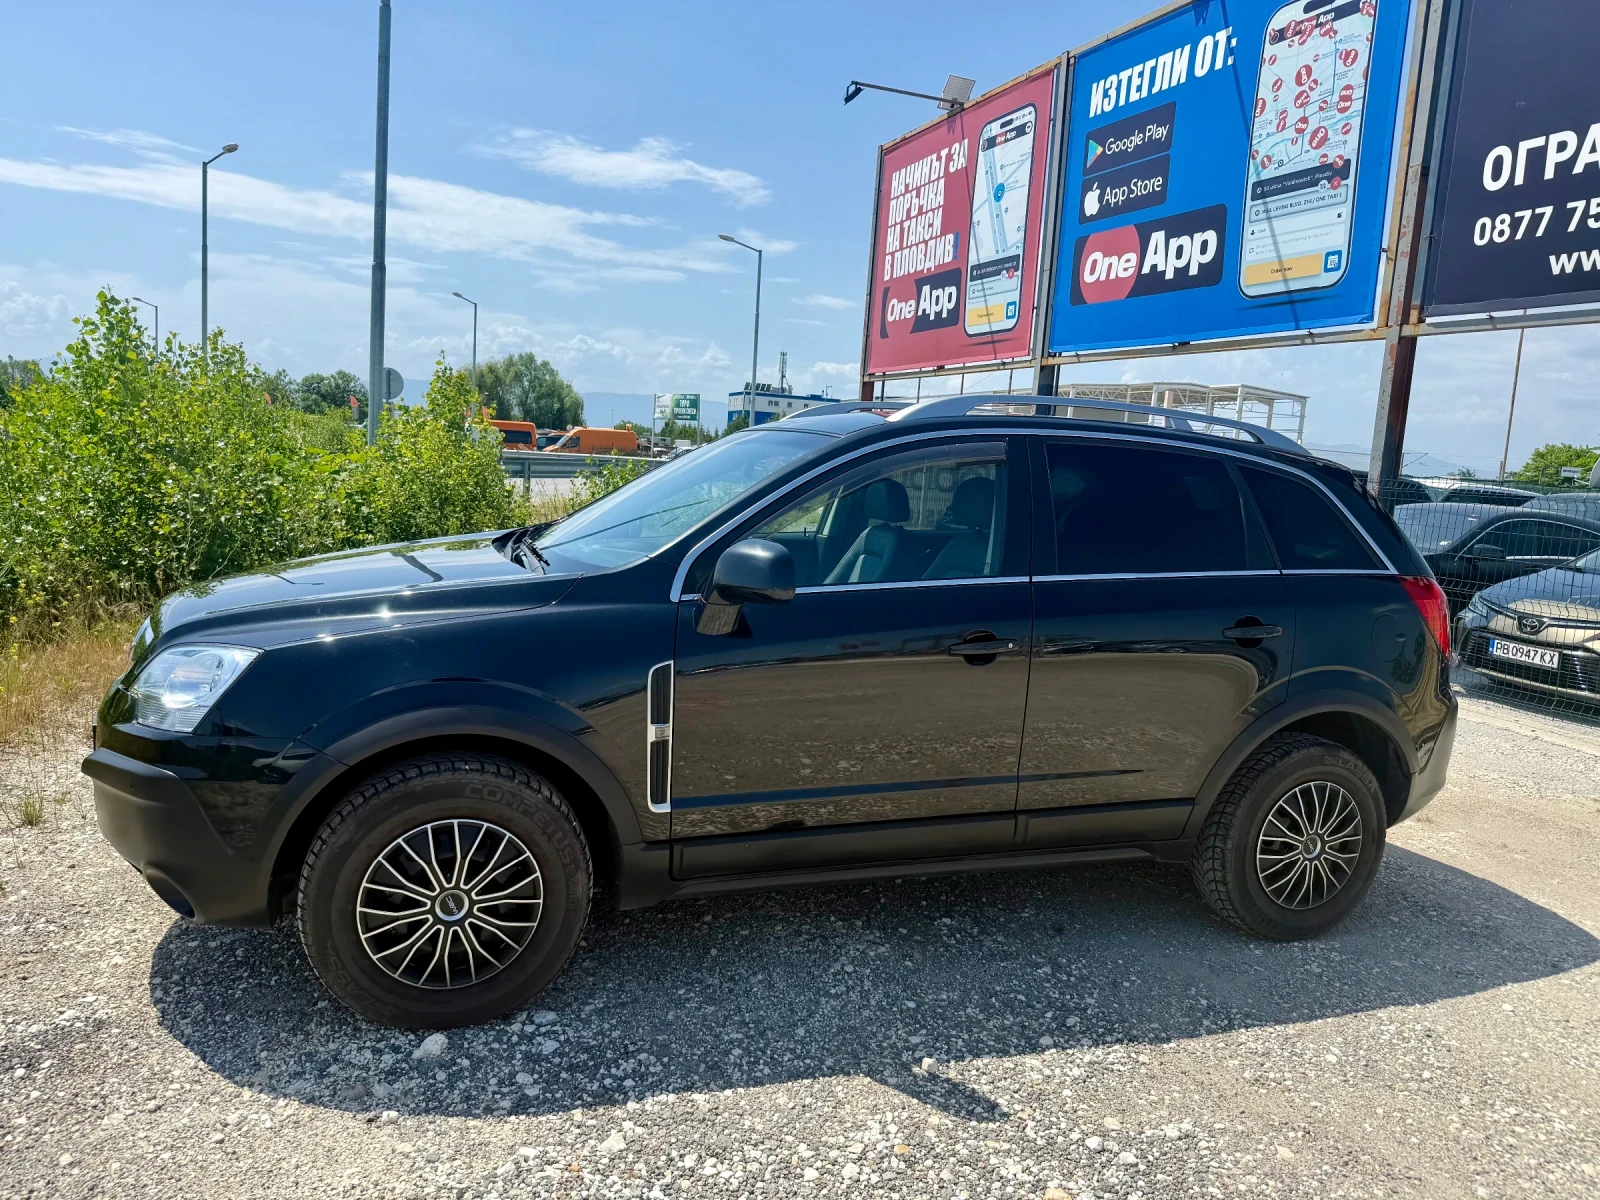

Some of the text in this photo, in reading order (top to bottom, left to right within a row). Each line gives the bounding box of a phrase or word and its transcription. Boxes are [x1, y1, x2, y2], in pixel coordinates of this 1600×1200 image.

[1317, 11, 1335, 24] App
[1089, 26, 1237, 119] ИЗТЕГЛИ ОТ:
[1337, 100, 1352, 109] One
[1105, 123, 1170, 155] Google Play
[1295, 121, 1308, 129] One
[1311, 127, 1326, 148] One
[890, 147, 949, 199] НАЧИНЪТ
[948, 138, 969, 173] ЗА
[1482, 122, 1600, 192] ОГРА
[888, 177, 945, 227] ПОРЪЧКА
[1102, 176, 1163, 208] App Store
[885, 207, 943, 254] НА ТАКСИ
[1473, 196, 1600, 247] 0877 75
[883, 231, 960, 282] В ПЛОВДИВ!
[1083, 229, 1218, 284] One App
[887, 284, 957, 322] One App
[1495, 642, 1556, 665] PB 0947 KX
[1337, 756, 1376, 794] LASSA
[464, 783, 575, 865] COMPETUS
[445, 895, 459, 916] WRC
